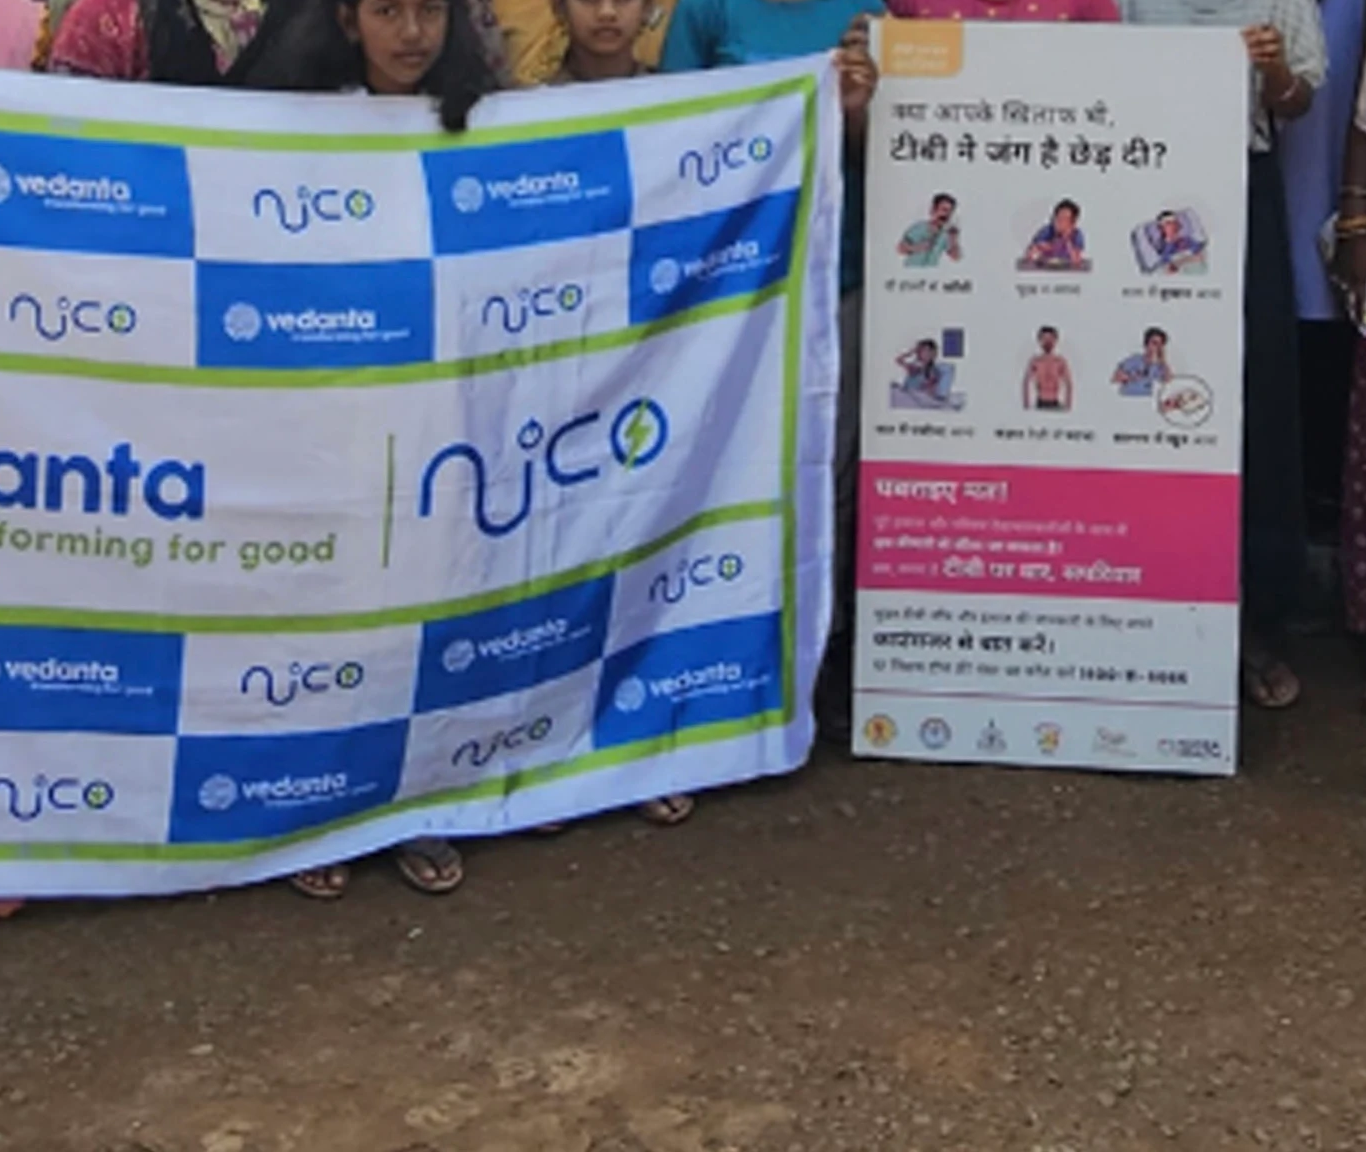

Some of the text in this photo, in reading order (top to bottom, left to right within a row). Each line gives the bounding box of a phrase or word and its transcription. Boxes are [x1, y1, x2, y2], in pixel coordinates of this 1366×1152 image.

[890, 130, 1167, 174] टीबी ने जंग है छेड़ दी?
[15, 173, 131, 201] vedanta
[266, 307, 375, 331] vedanta
[168, 533, 226, 563] for
[239, 533, 337, 571] good
[943, 555, 984, 579] टीबी
[5, 658, 119, 682] vedanta
